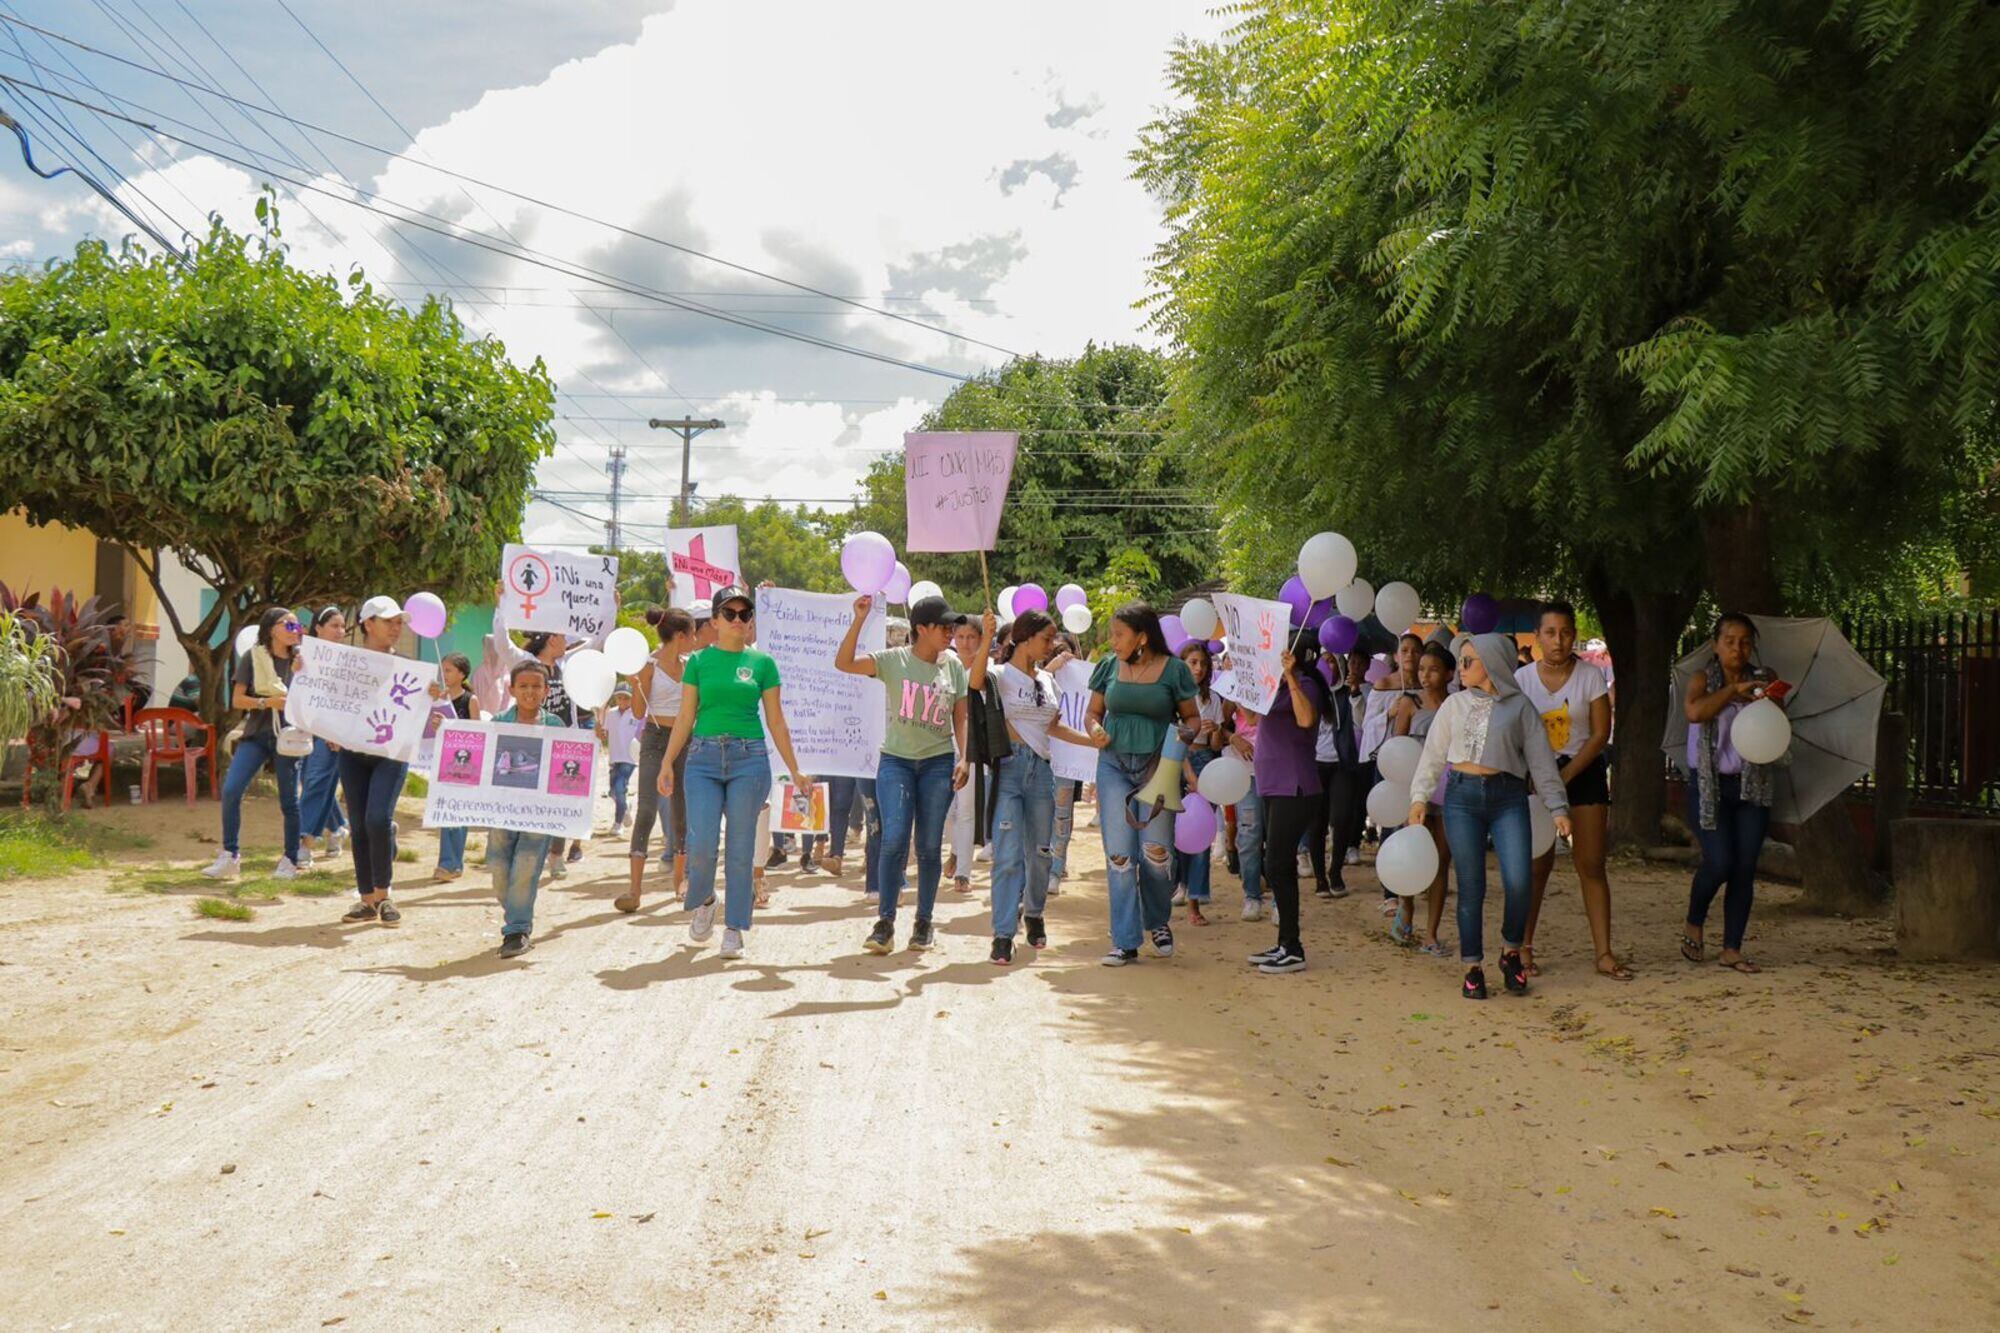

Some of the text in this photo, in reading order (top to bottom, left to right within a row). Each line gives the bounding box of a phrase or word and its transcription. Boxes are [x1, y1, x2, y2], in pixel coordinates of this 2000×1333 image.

[807, 610, 852, 628] Despedid
[313, 645, 369, 671] NO MAS
[318, 665, 381, 687] VIOLENCIA
[296, 675, 369, 700] CONTRA LAS
[899, 679, 946, 725] NYC
[446, 731, 483, 742] VIVAS
[554, 741, 592, 752] VIVAS
